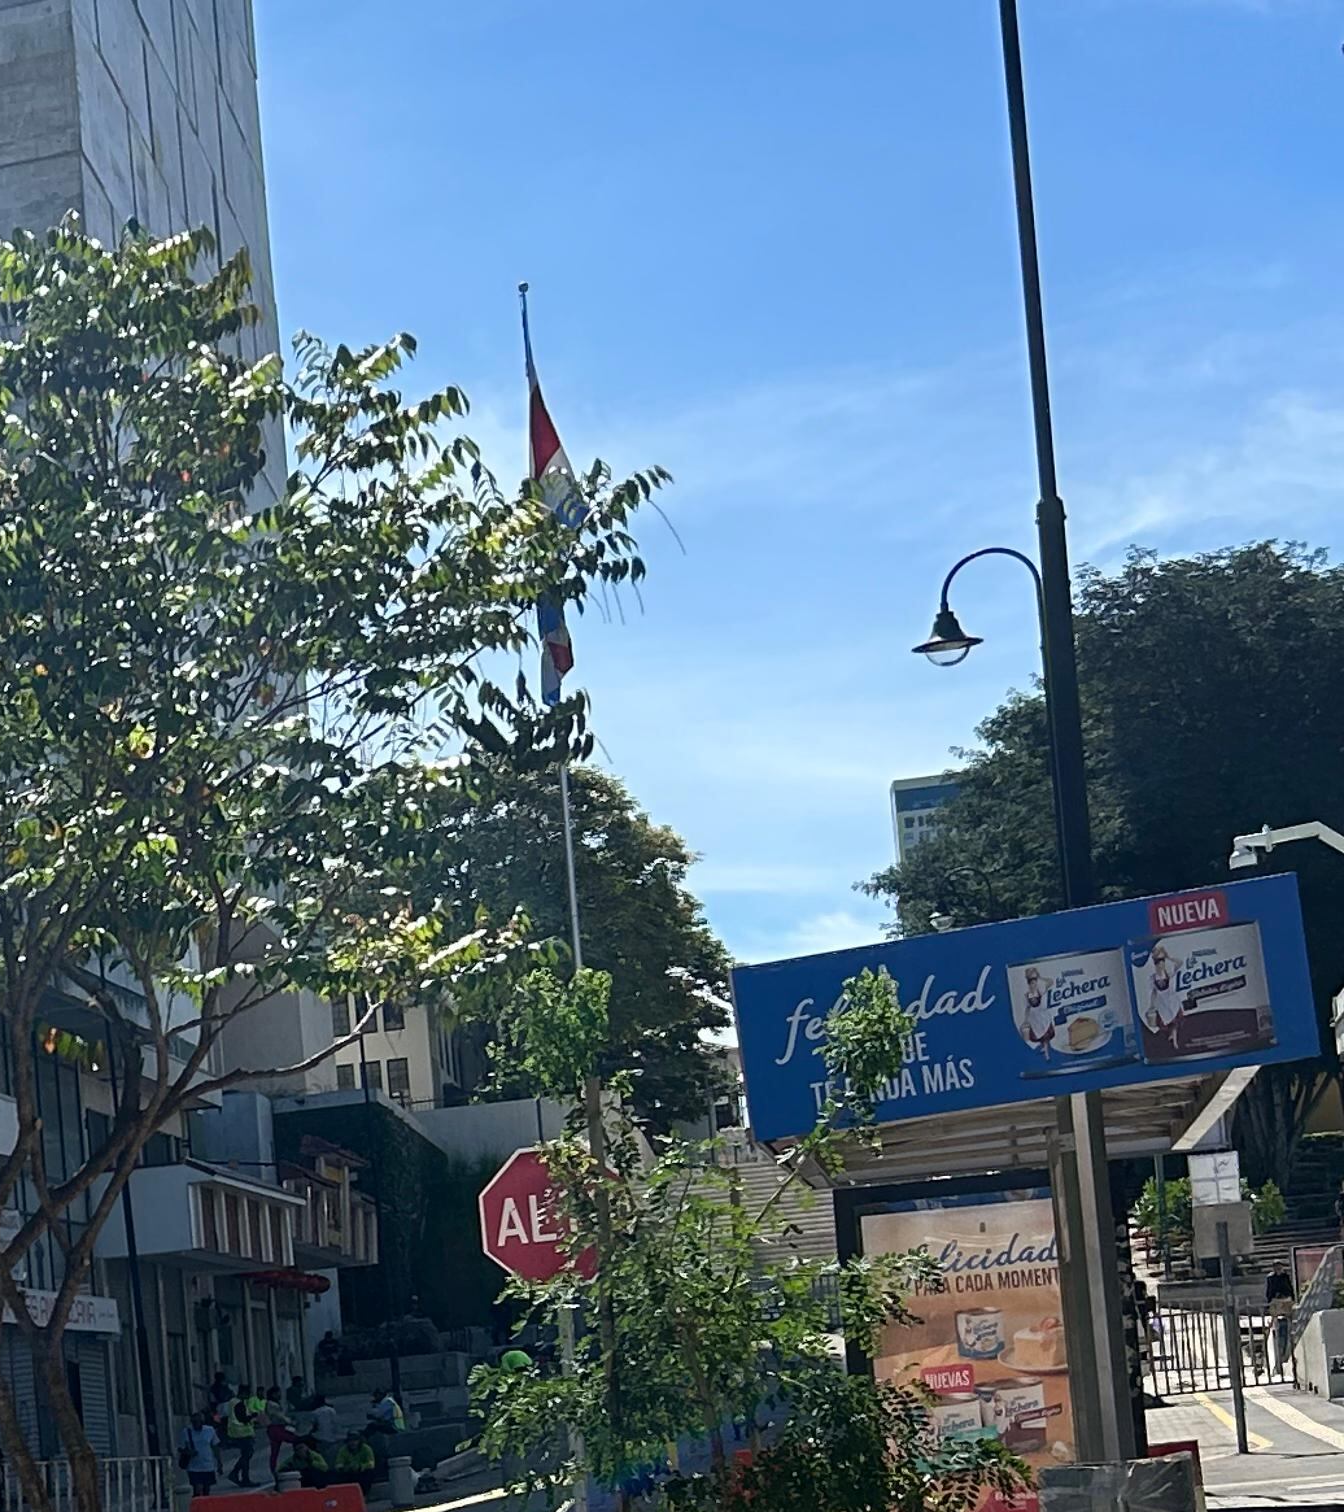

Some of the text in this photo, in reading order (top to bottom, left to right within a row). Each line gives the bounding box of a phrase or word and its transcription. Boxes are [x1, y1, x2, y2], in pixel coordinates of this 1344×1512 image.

[1158, 897, 1220, 928] NUEVA
[1175, 955, 1248, 992] Lechera
[1047, 975, 1111, 1009] Lechera
[775, 965, 996, 1065] feldad
[921, 1055, 975, 1095] MÁS
[955, 1272, 994, 1293] CADA
[998, 1266, 1060, 1289] MOMENT
[924, 1369, 970, 1389] NUEVAS
